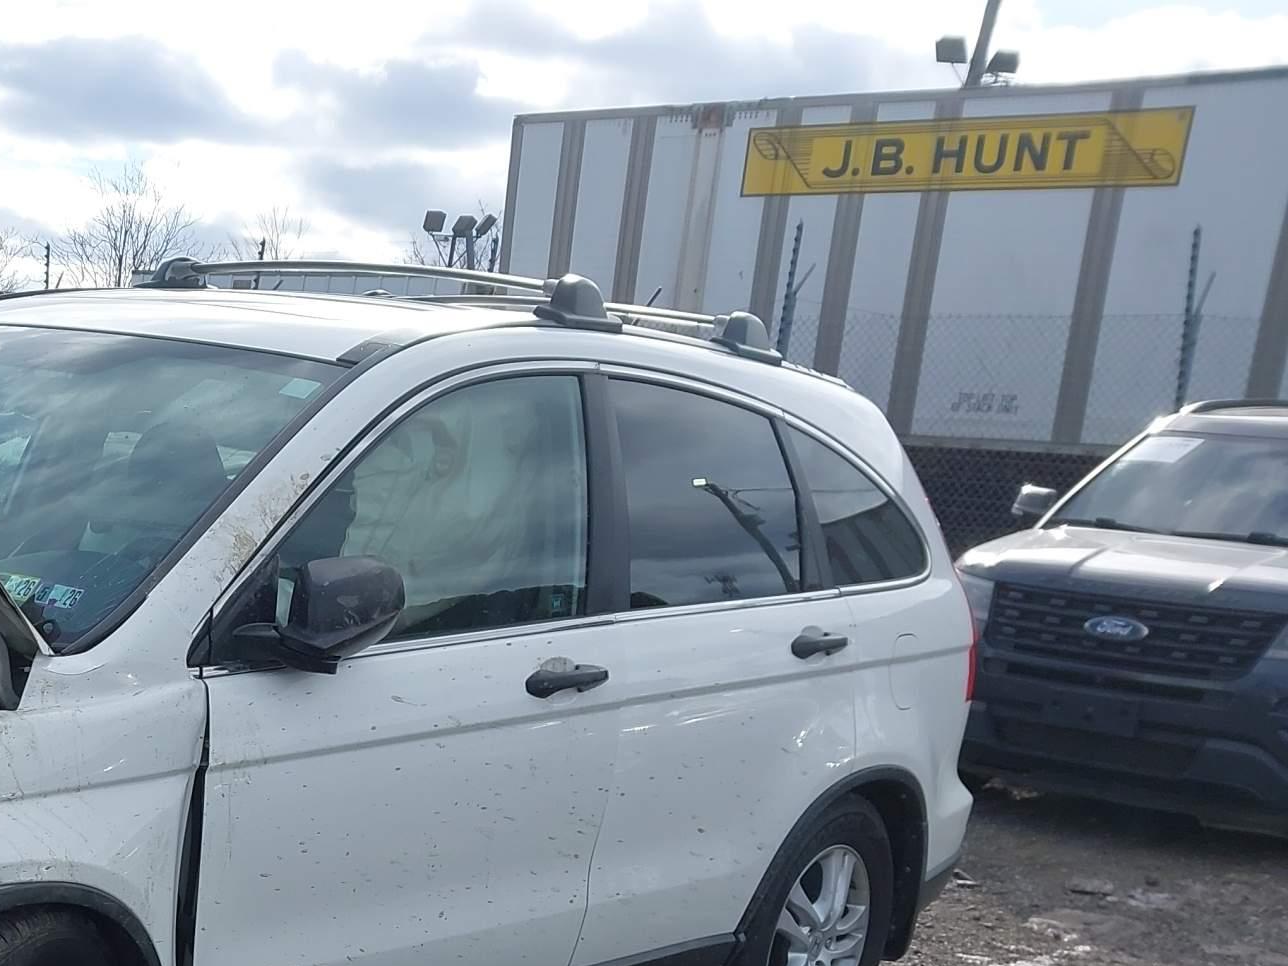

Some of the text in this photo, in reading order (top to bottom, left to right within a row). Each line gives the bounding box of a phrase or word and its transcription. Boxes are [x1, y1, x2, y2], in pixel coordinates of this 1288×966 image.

[822, 130, 1091, 178] J.B. HUNT
[1095, 619, 1133, 637] Ford
